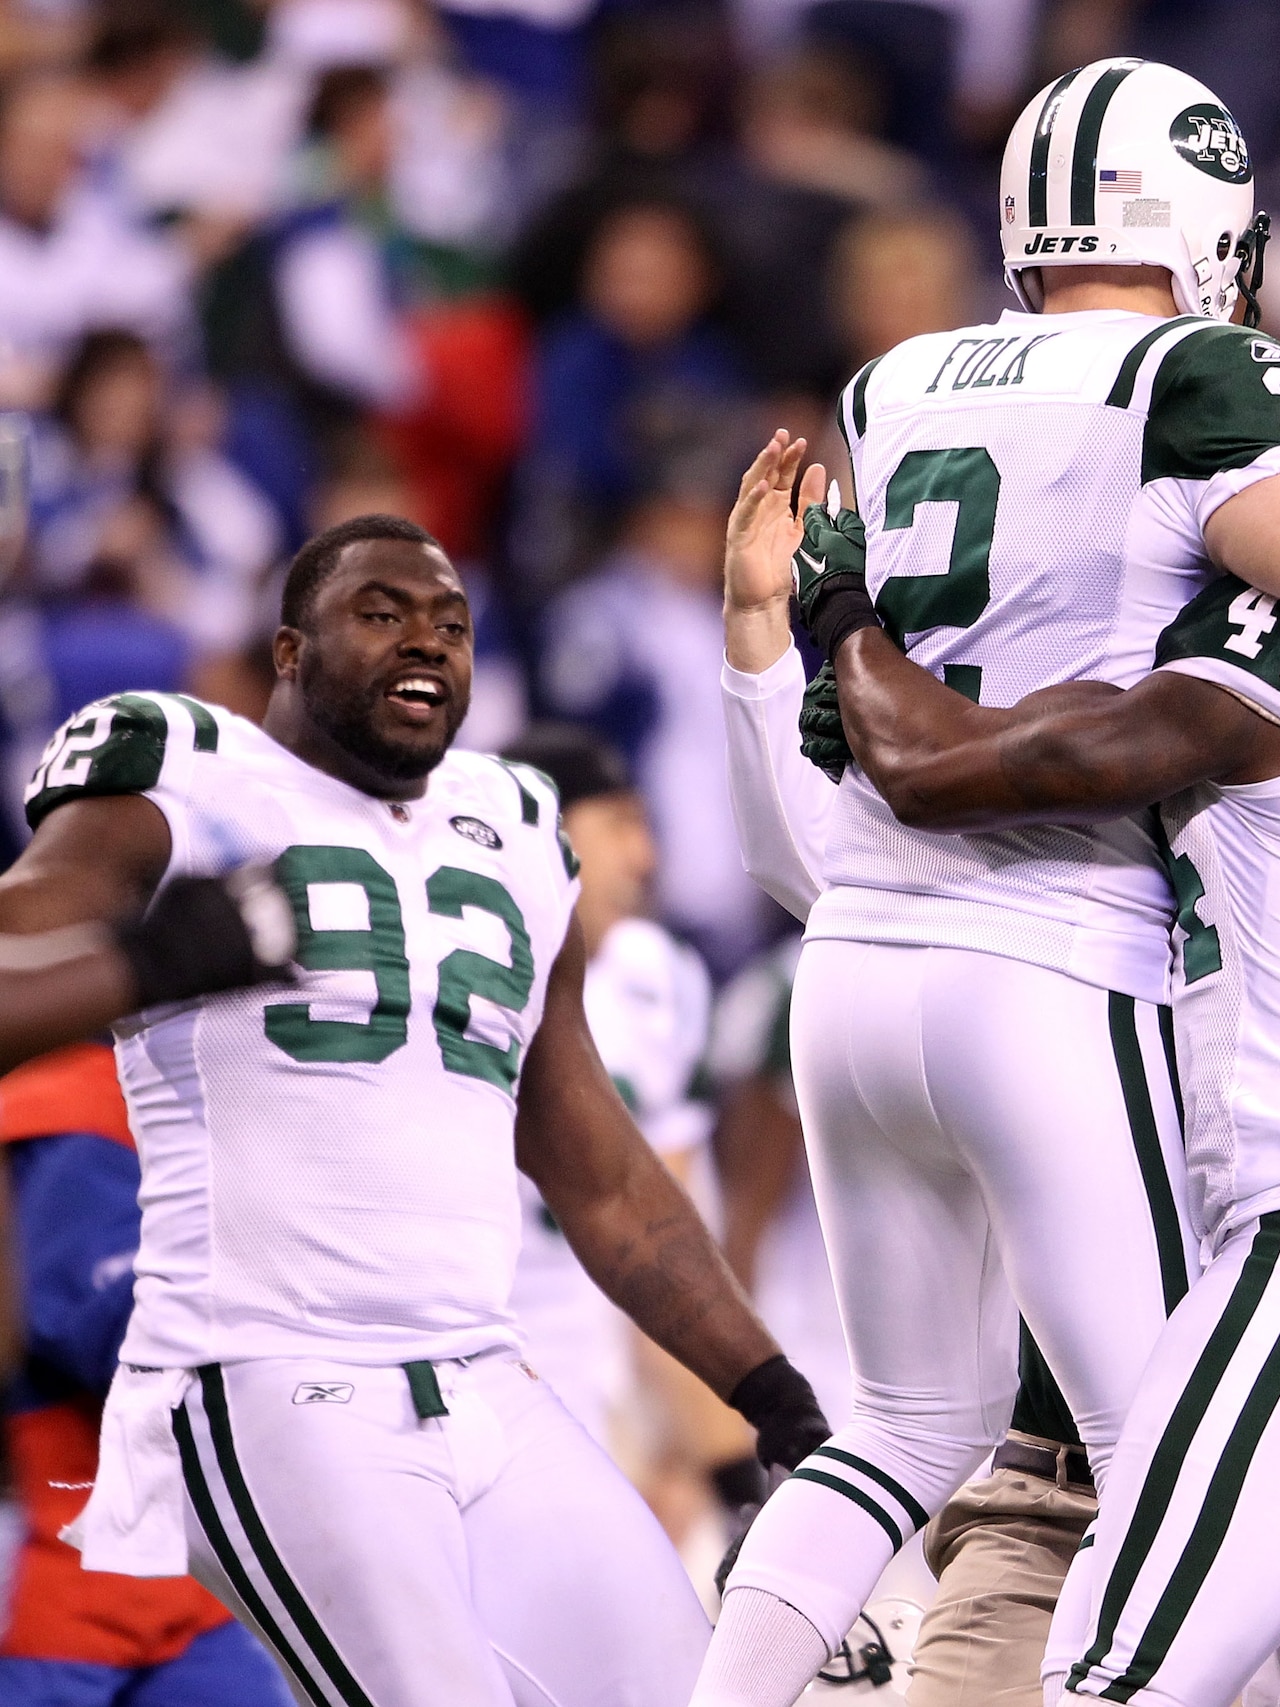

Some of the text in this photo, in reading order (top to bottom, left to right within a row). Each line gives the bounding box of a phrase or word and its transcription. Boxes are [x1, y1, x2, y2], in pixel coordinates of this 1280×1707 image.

[1187, 124, 1248, 157] JETS
[1024, 233, 1099, 255] JETS
[925, 331, 1062, 394] FOLK
[874, 447, 1001, 700] 2
[23, 707, 117, 805] 92
[264, 845, 536, 1098] 92
